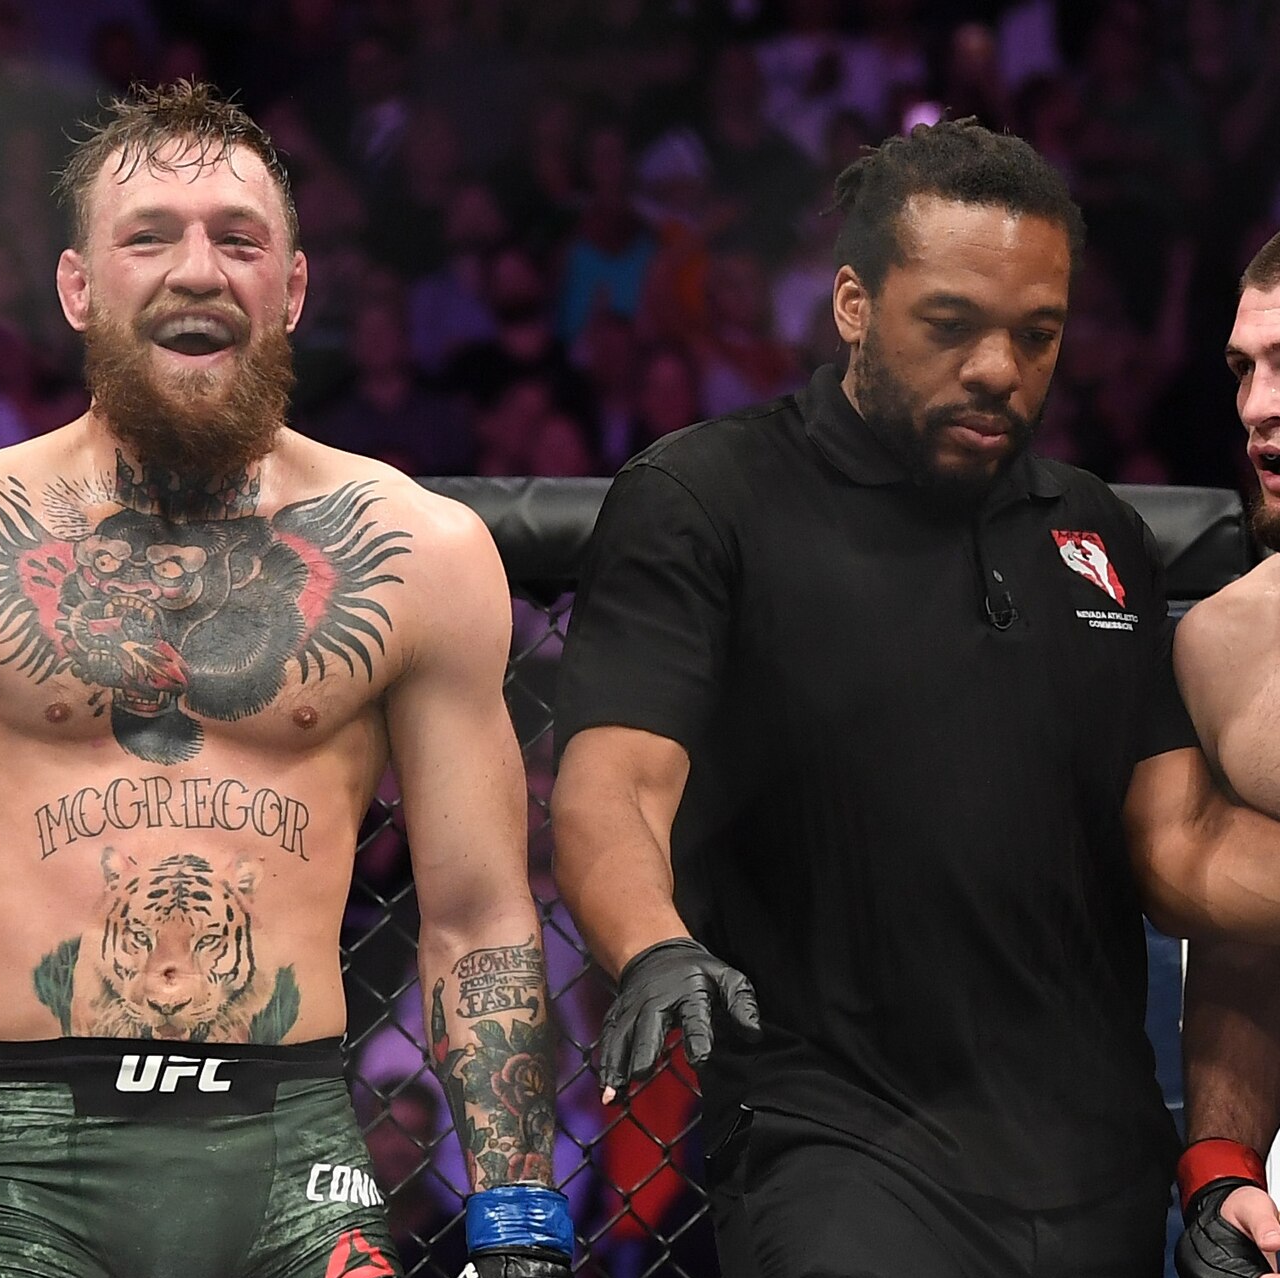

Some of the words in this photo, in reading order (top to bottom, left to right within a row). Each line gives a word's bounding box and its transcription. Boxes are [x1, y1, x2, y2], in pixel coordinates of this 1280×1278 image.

[34, 776, 310, 862] MCGREGOR
[458, 949, 510, 978] SLOW
[467, 985, 527, 1014] FAST
[116, 1055, 239, 1093] UFC
